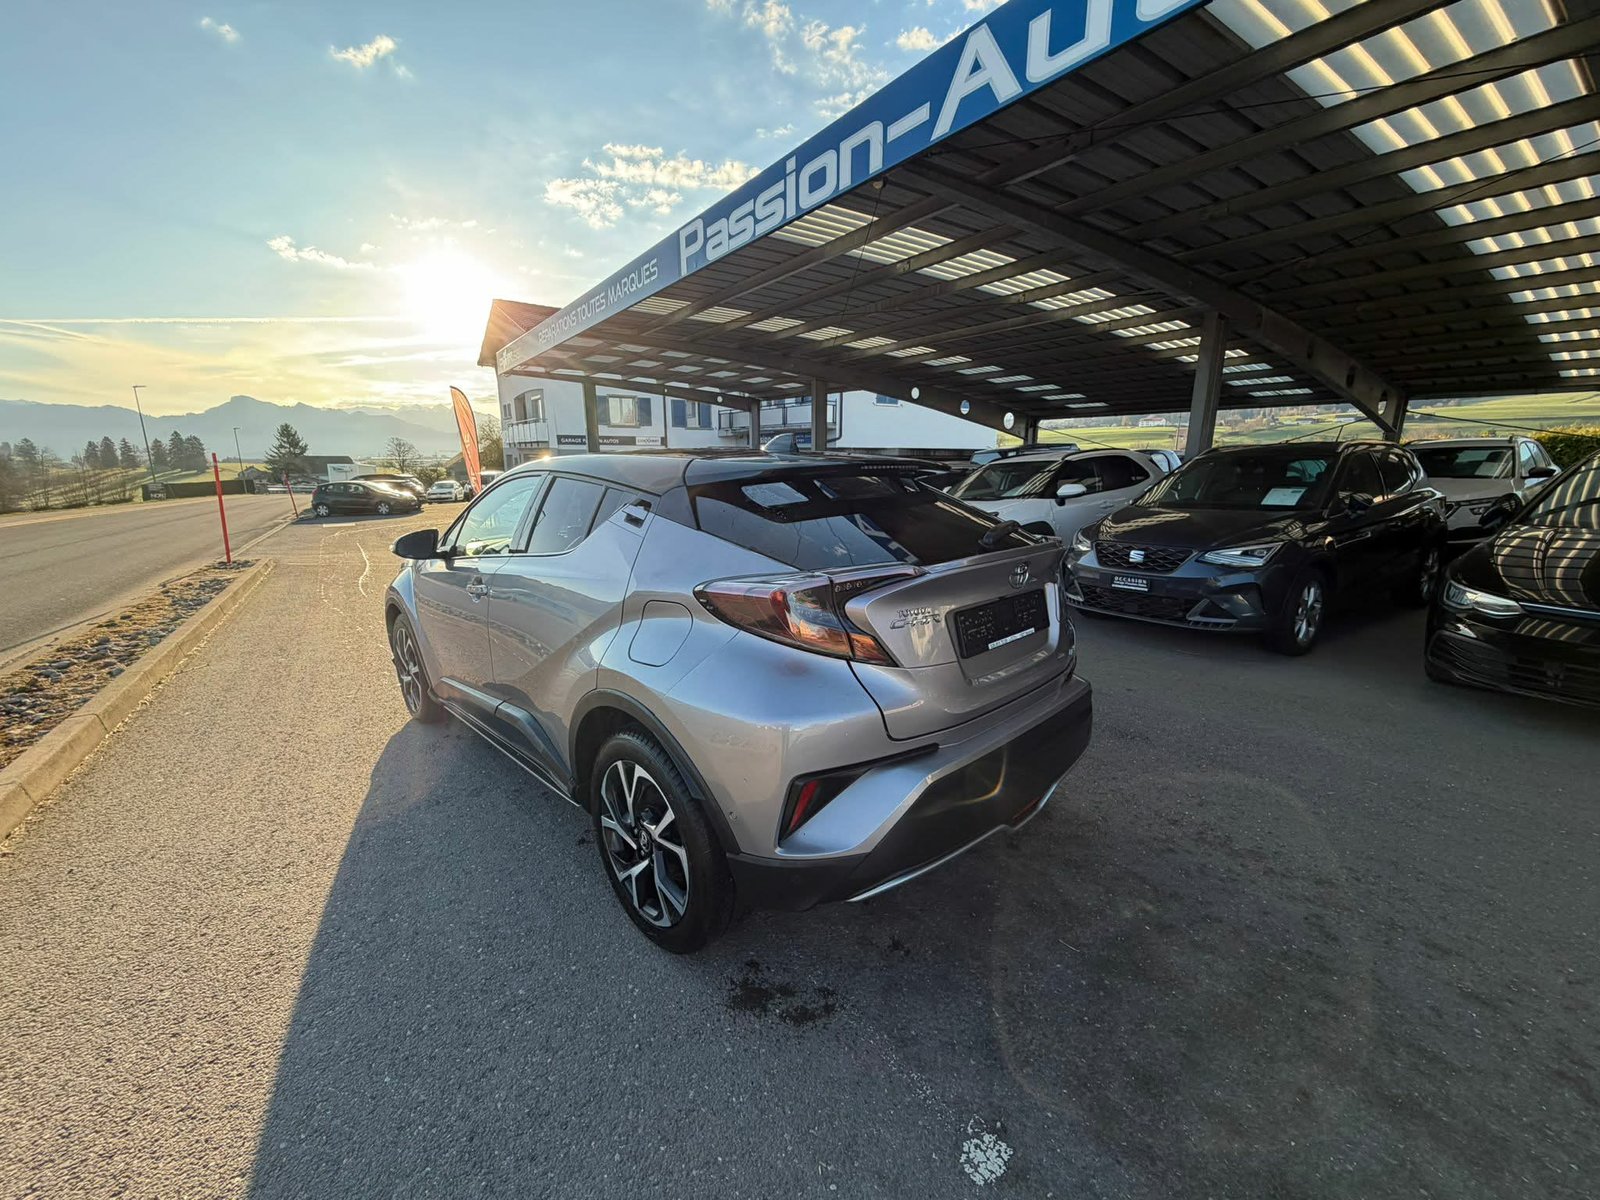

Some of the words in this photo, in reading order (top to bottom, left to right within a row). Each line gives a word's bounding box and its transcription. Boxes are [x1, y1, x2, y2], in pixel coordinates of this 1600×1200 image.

[679, 0, 1191, 277] Passion-Au
[577, 291, 606, 321] TOUTES
[607, 258, 658, 306] MARQUES
